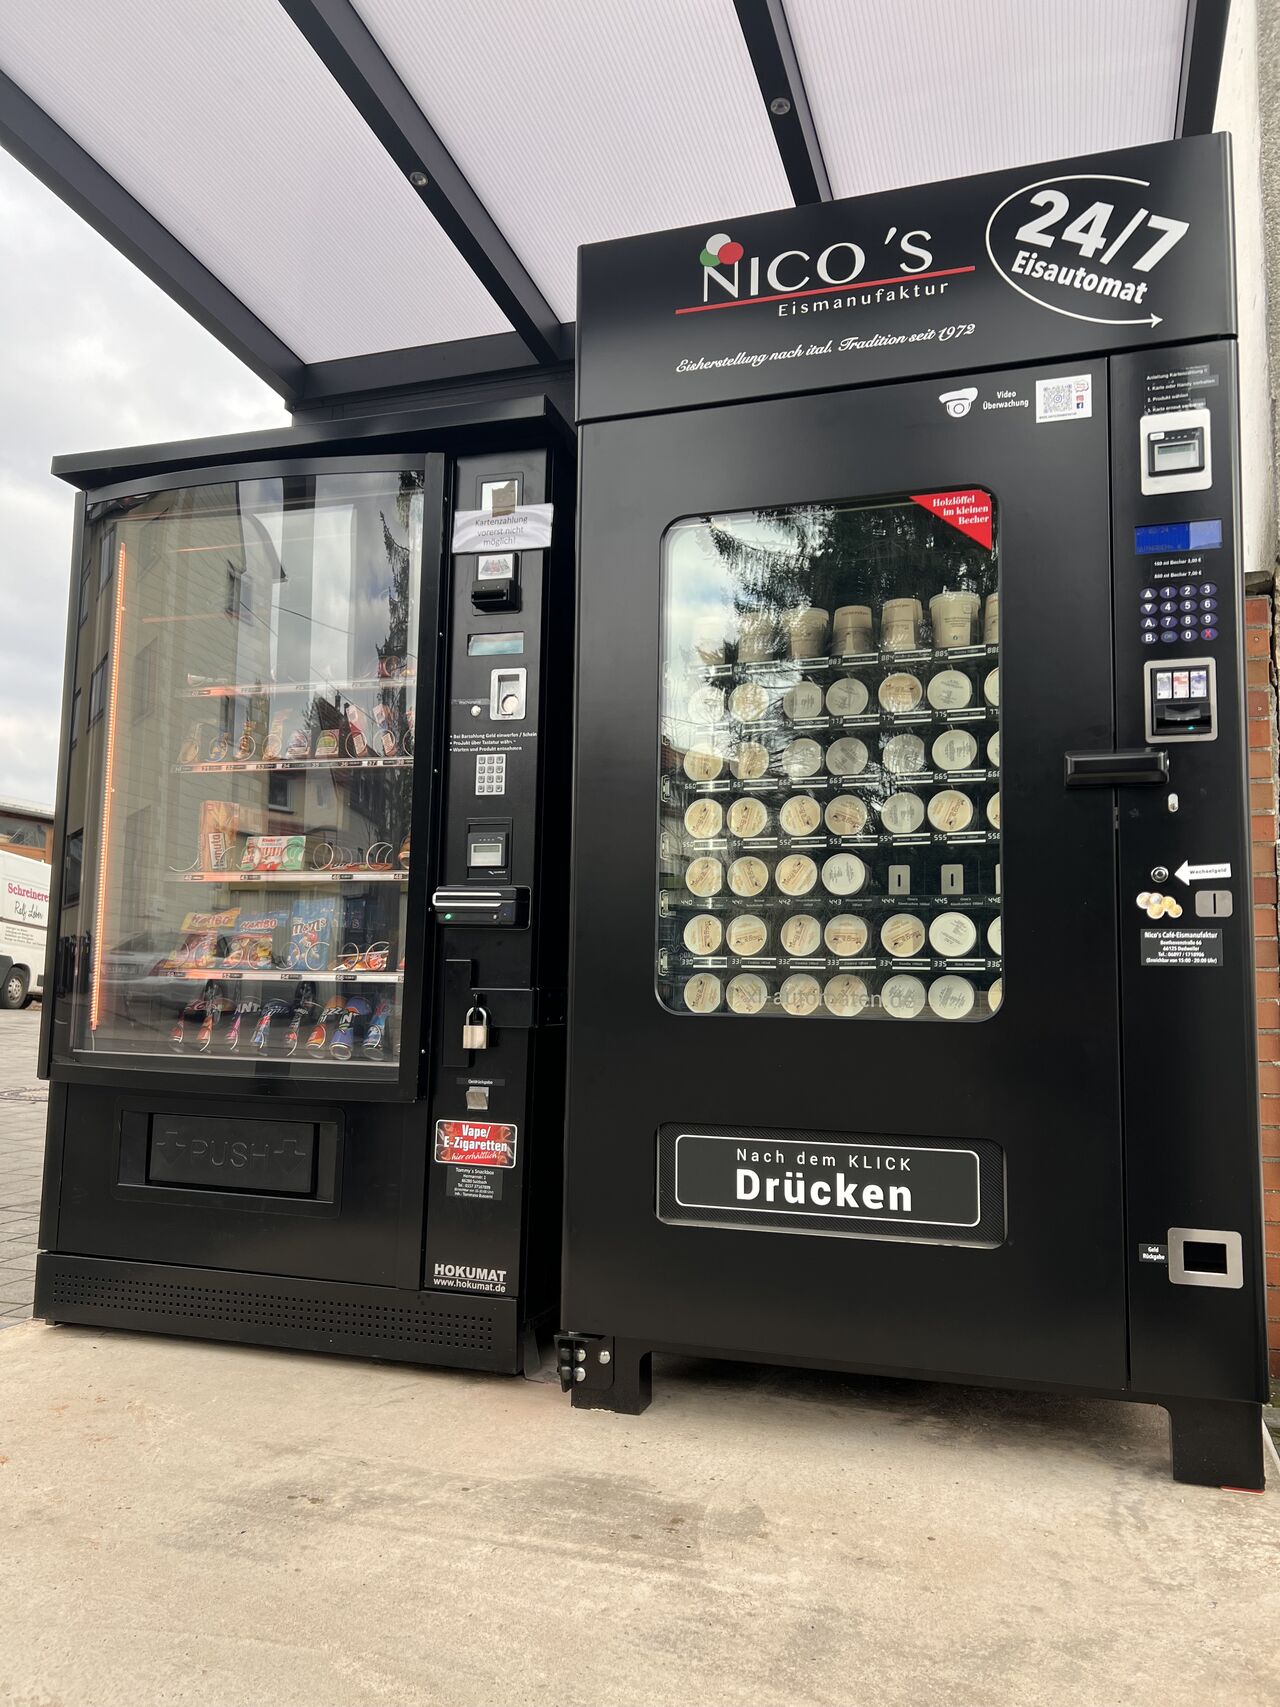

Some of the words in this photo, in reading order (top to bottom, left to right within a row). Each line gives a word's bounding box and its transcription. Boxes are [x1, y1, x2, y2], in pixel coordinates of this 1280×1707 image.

[1015, 190, 1190, 272] 24/7
[1011, 250, 1148, 304] Eisautomat
[778, 282, 948, 317] Eismanufaktur
[676, 351, 768, 373] Eisherstellung
[768, 343, 804, 361] nach
[805, 341, 832, 356] ital.
[838, 333, 906, 351] Tradition
[908, 329, 935, 342] seit
[938, 323, 976, 342] 1972
[996, 390, 1016, 398] Video
[982, 398, 1029, 410] Überwachung
[932, 494, 975, 507] Holzlöffel
[944, 508, 954, 516] im
[956, 506, 988, 515] kleinen
[475, 516, 528, 526] Kartenzahlung
[958, 515, 990, 525] Becher
[478, 526, 504, 537] vorerst
[504, 526, 524, 535] nicht
[483, 536, 516, 547] möglich!
[1164, 588, 1170, 596] 1
[1184, 586, 1190, 595] 2
[1204, 585, 1210, 594] 3
[1164, 602, 1171, 611] 4
[1184, 602, 1190, 610] 5
[1204, 600, 1210, 608] 6
[1165, 618, 1172, 626] 7
[1185, 616, 1191, 624] 8
[1205, 614, 1211, 623] 9
[1186, 631, 1192, 640] 0
[240, 918, 279, 930] HARIBO
[462, 1124, 492, 1138] Vape/
[444, 1136, 508, 1152] E-Zigaretten
[191, 1139, 270, 1168] PUSH
[450, 1152, 464, 1160] hier
[736, 1148, 786, 1164] Nach
[796, 1152, 836, 1167] dem
[848, 1154, 912, 1172] KLICK
[736, 1168, 912, 1212] Drücken
[1142, 1253, 1165, 1261] Rückgabe
[434, 1264, 507, 1282] HOKUMAT
[433, 1278, 506, 1293] www.hokumat.de
